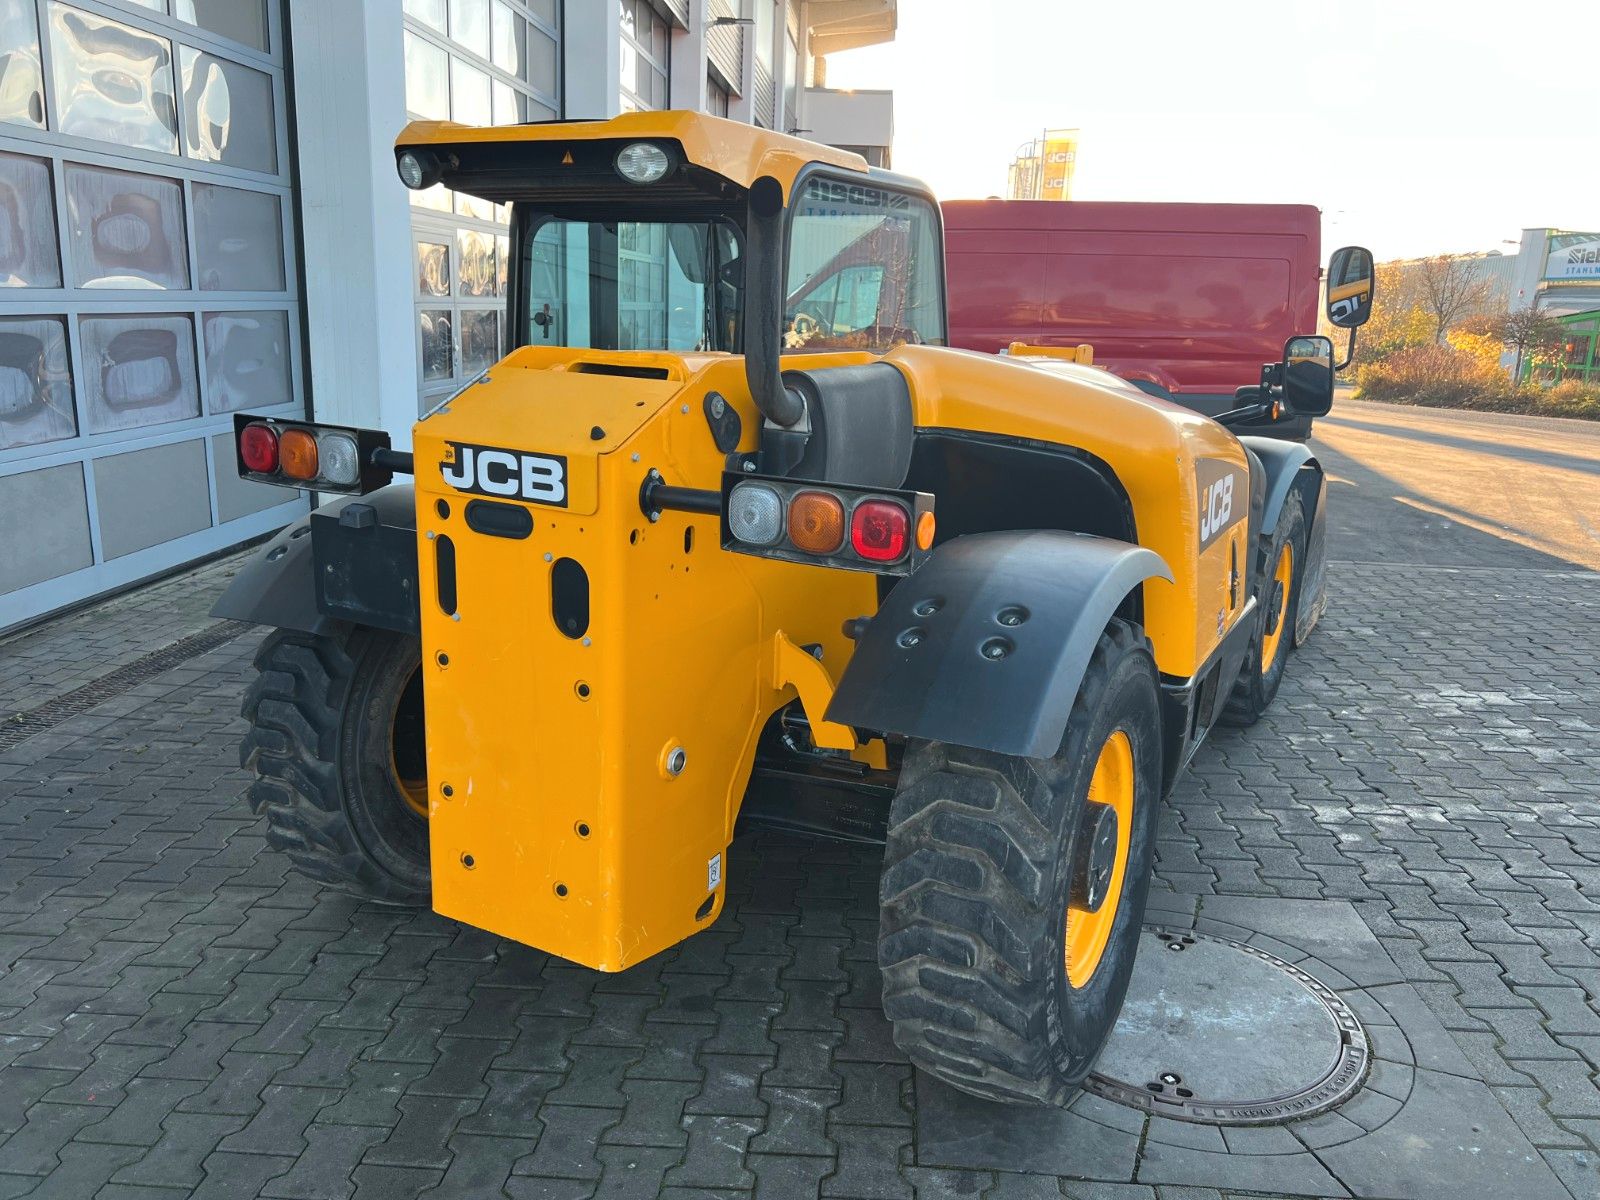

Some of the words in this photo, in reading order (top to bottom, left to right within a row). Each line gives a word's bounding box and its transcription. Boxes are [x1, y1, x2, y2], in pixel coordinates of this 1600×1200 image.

[1047, 152, 1074, 163] JCB
[442, 447, 565, 502] JCB
[1201, 473, 1234, 542] JCB
